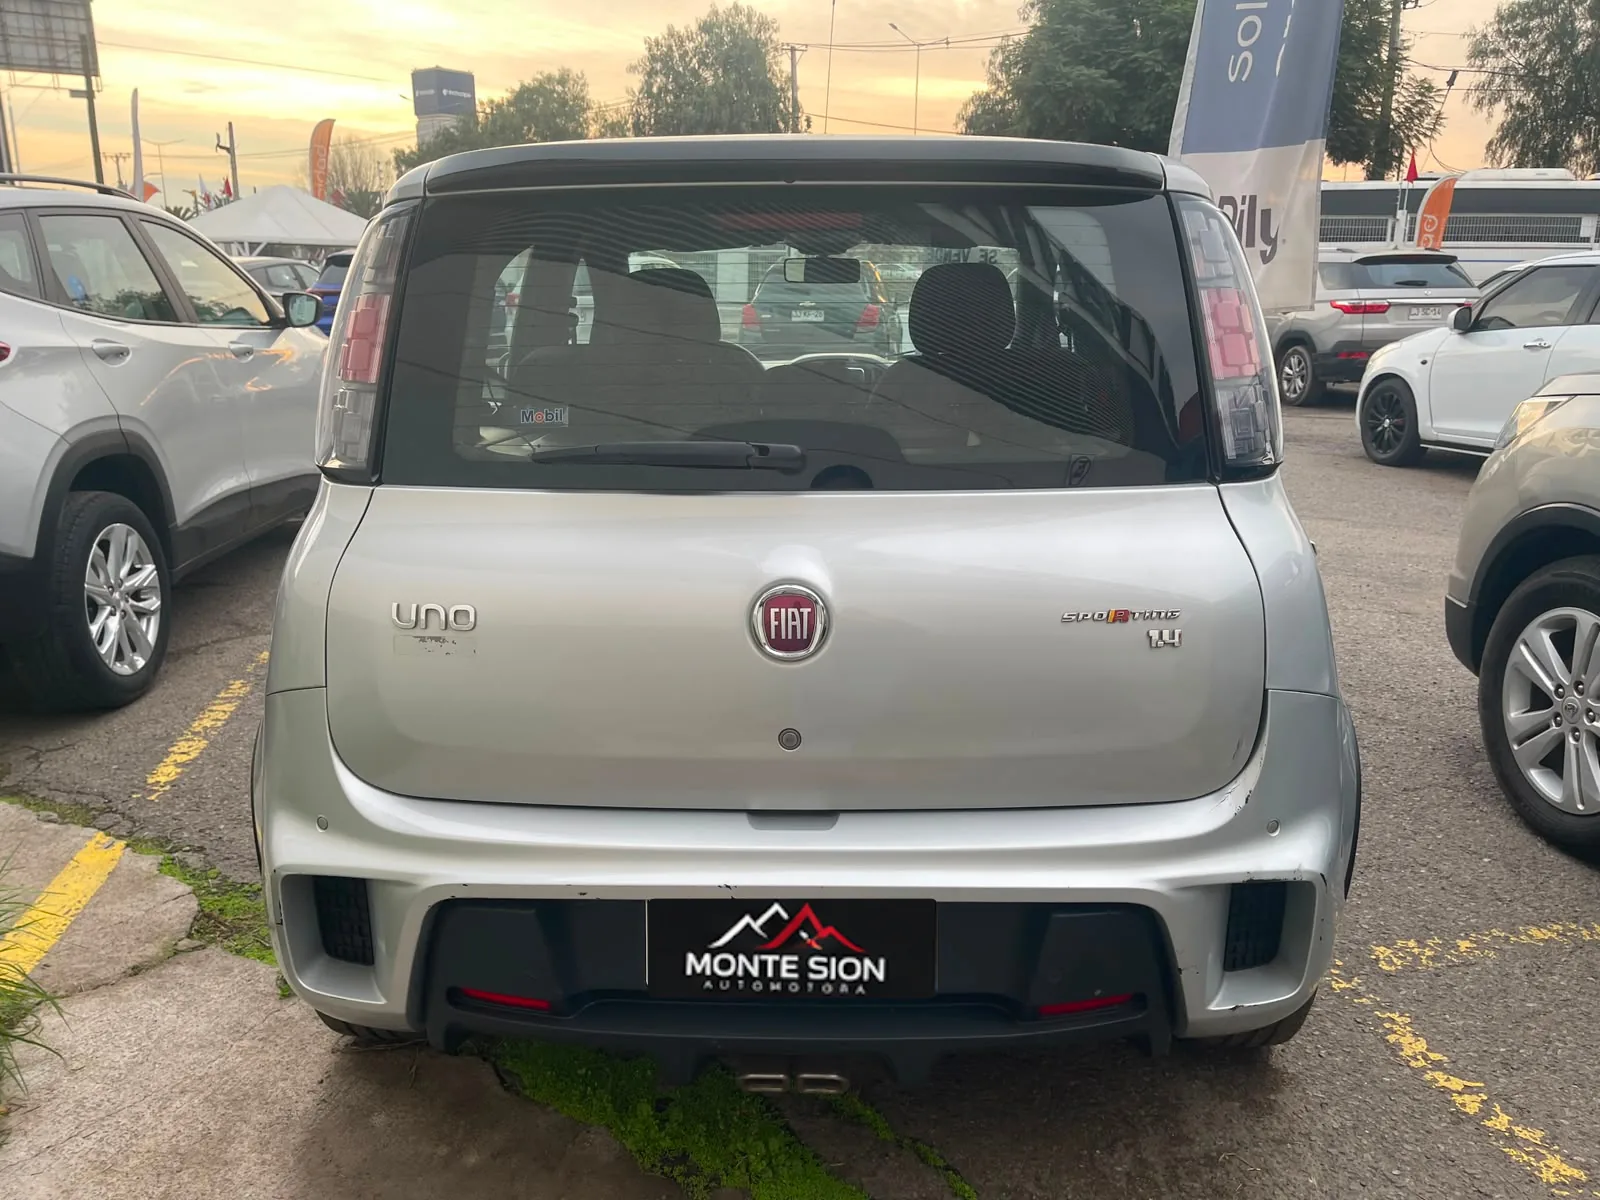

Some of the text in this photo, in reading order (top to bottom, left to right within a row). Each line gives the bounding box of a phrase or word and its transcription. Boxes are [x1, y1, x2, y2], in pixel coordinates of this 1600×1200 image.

[521, 408, 564, 424] Mobil
[770, 607, 812, 640] FIAT
[1147, 629, 1182, 648] 1.4
